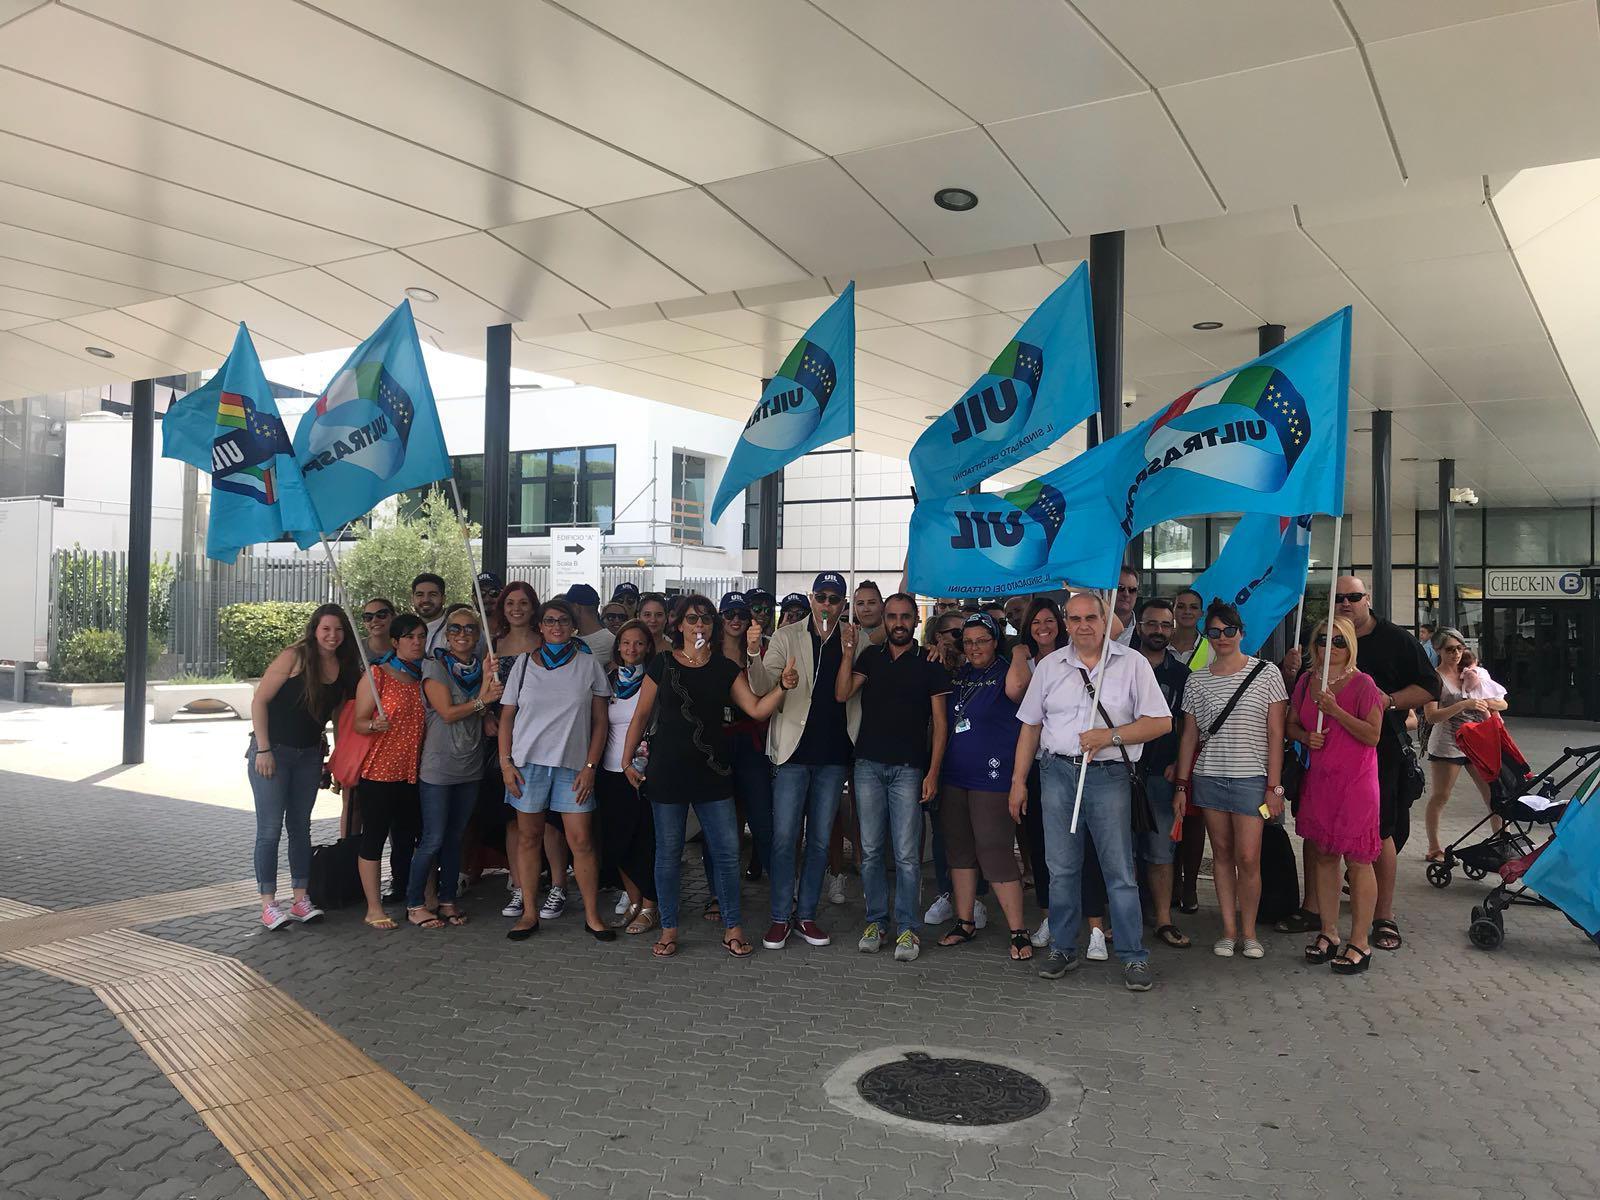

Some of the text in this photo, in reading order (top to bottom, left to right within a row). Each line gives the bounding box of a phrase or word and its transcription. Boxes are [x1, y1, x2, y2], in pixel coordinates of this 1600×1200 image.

[824, 574, 838, 582] UIL
[1491, 575, 1580, 592] CHECK-IN B
